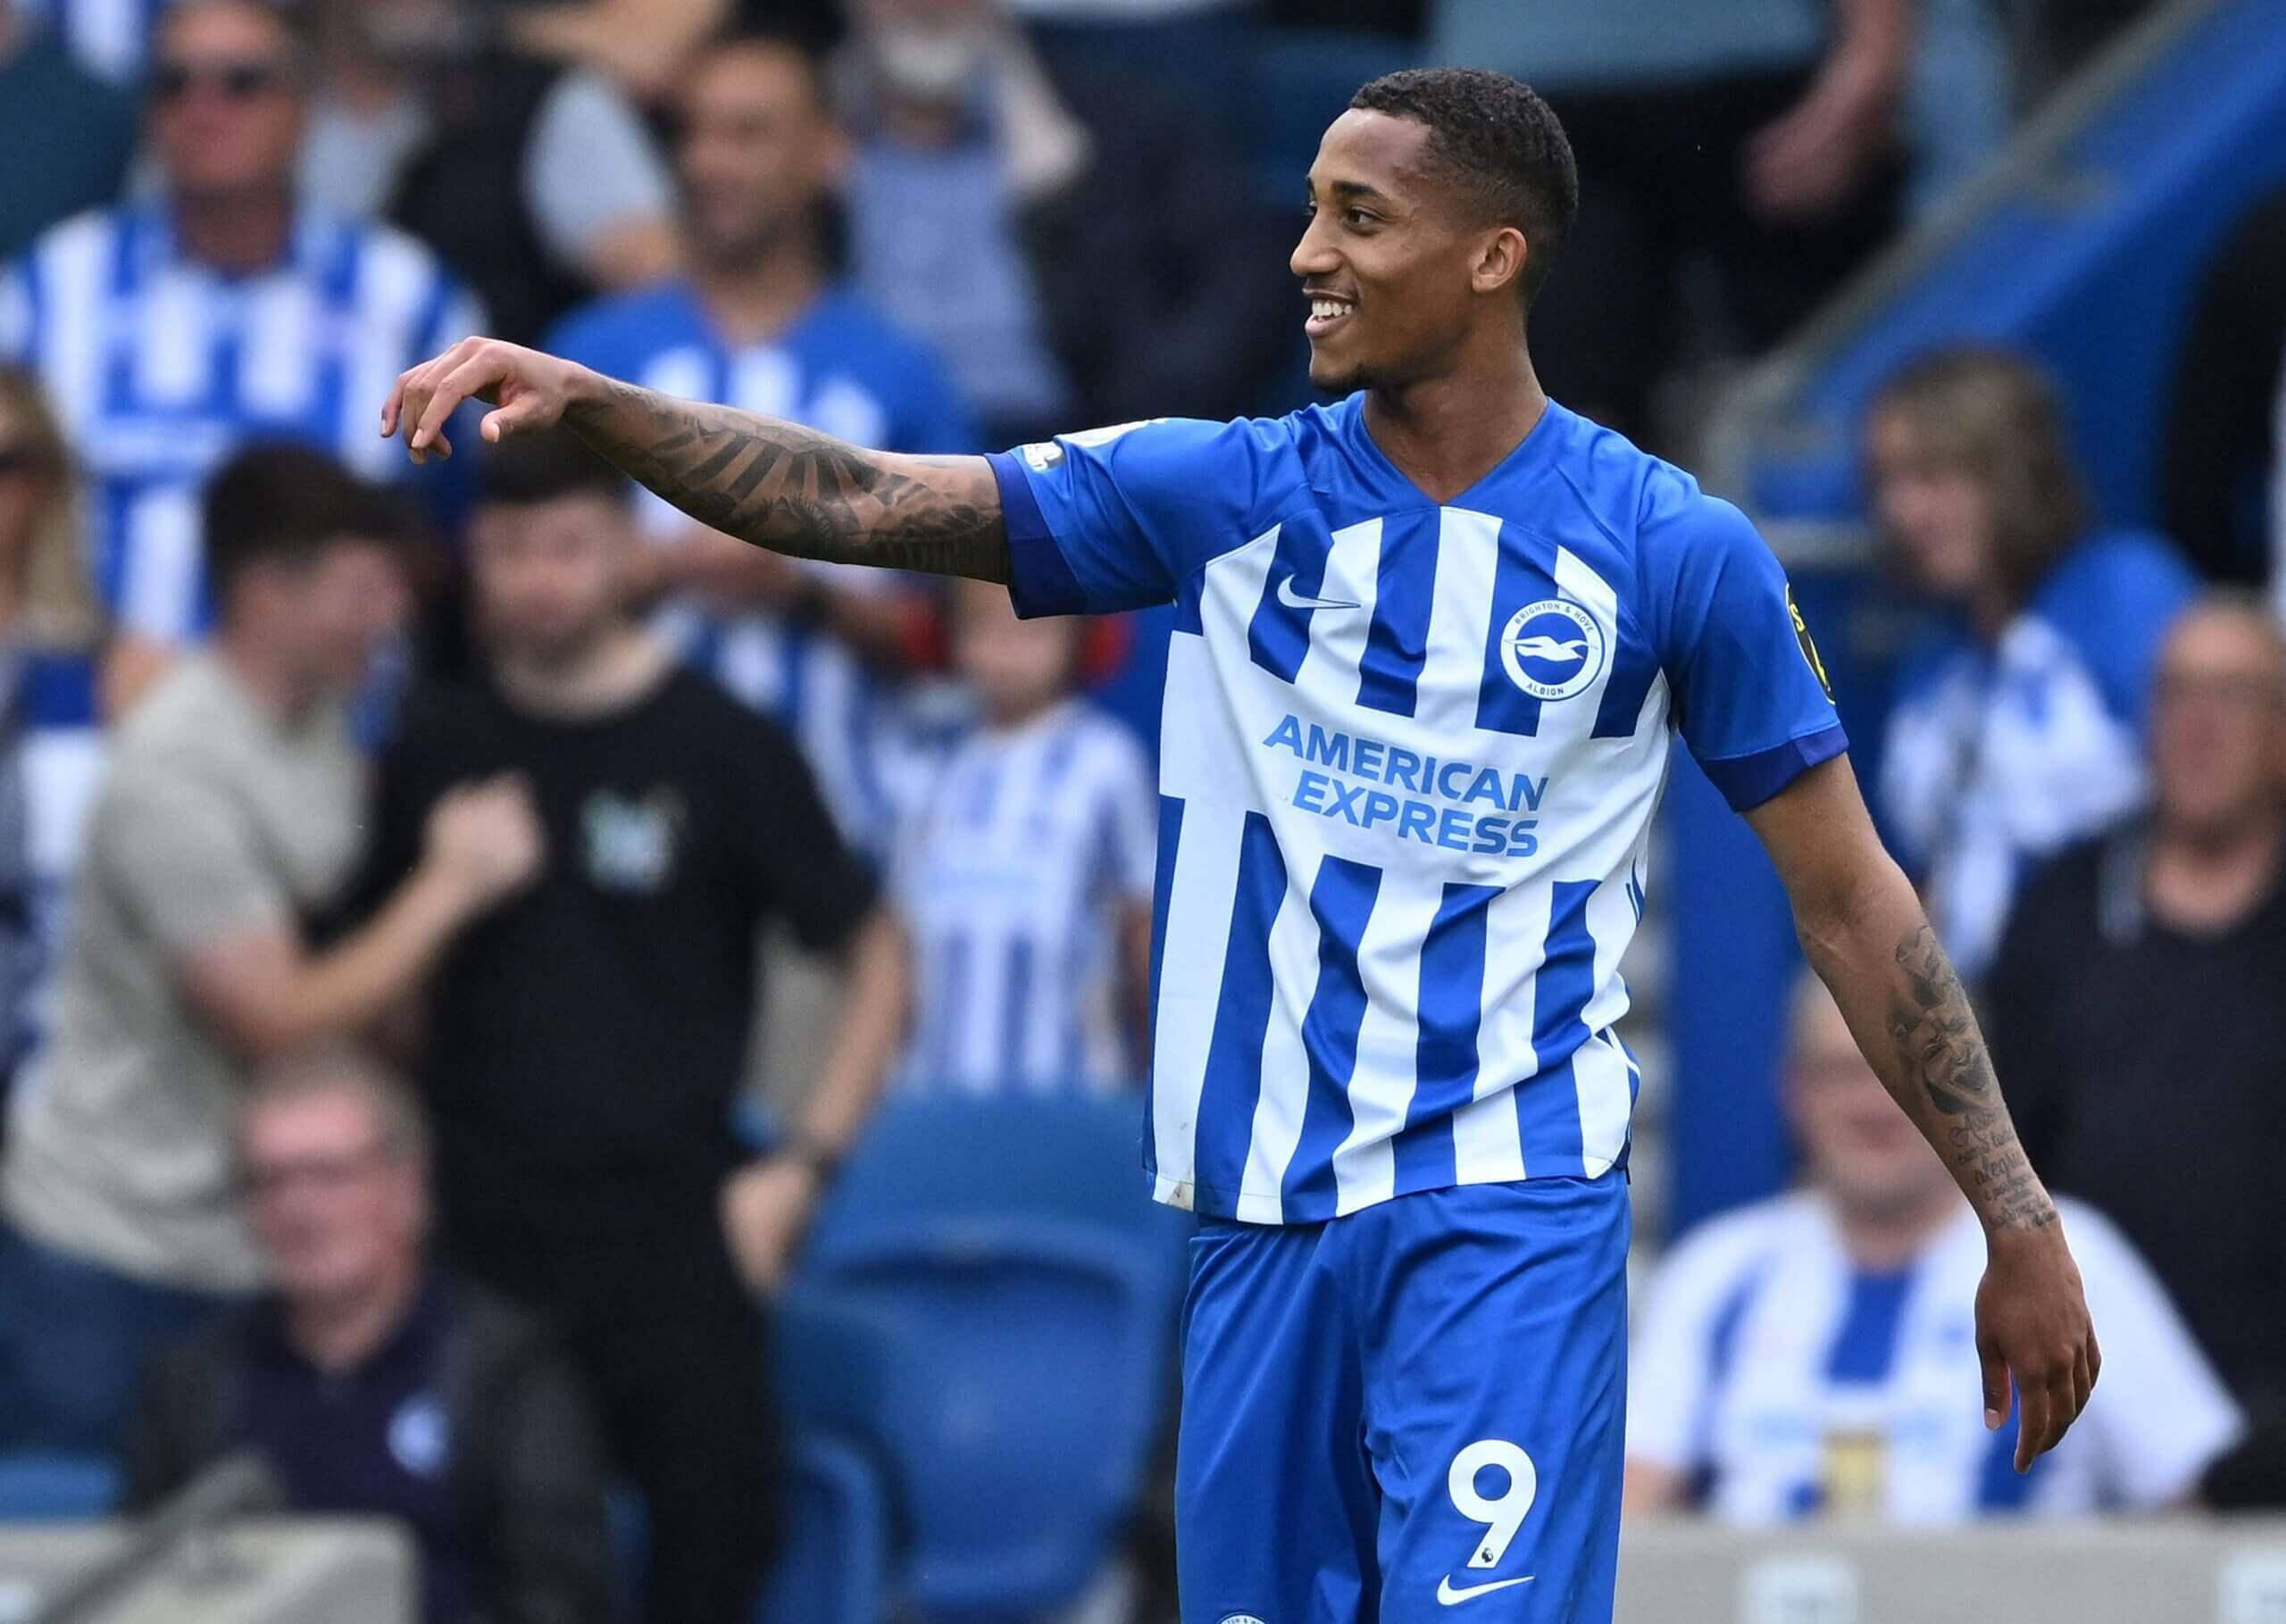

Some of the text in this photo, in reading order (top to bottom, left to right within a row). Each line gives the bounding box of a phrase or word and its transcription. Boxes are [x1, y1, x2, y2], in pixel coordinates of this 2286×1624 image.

[1514, 603, 1560, 625] BRIGHTON
[1574, 612, 1594, 633] HOVE
[1526, 683, 1564, 695] ALBION
[1262, 713, 1549, 812] AMERICAN
[1292, 769, 1539, 857] EXPRESS
[1448, 1438, 1537, 1569] 9
